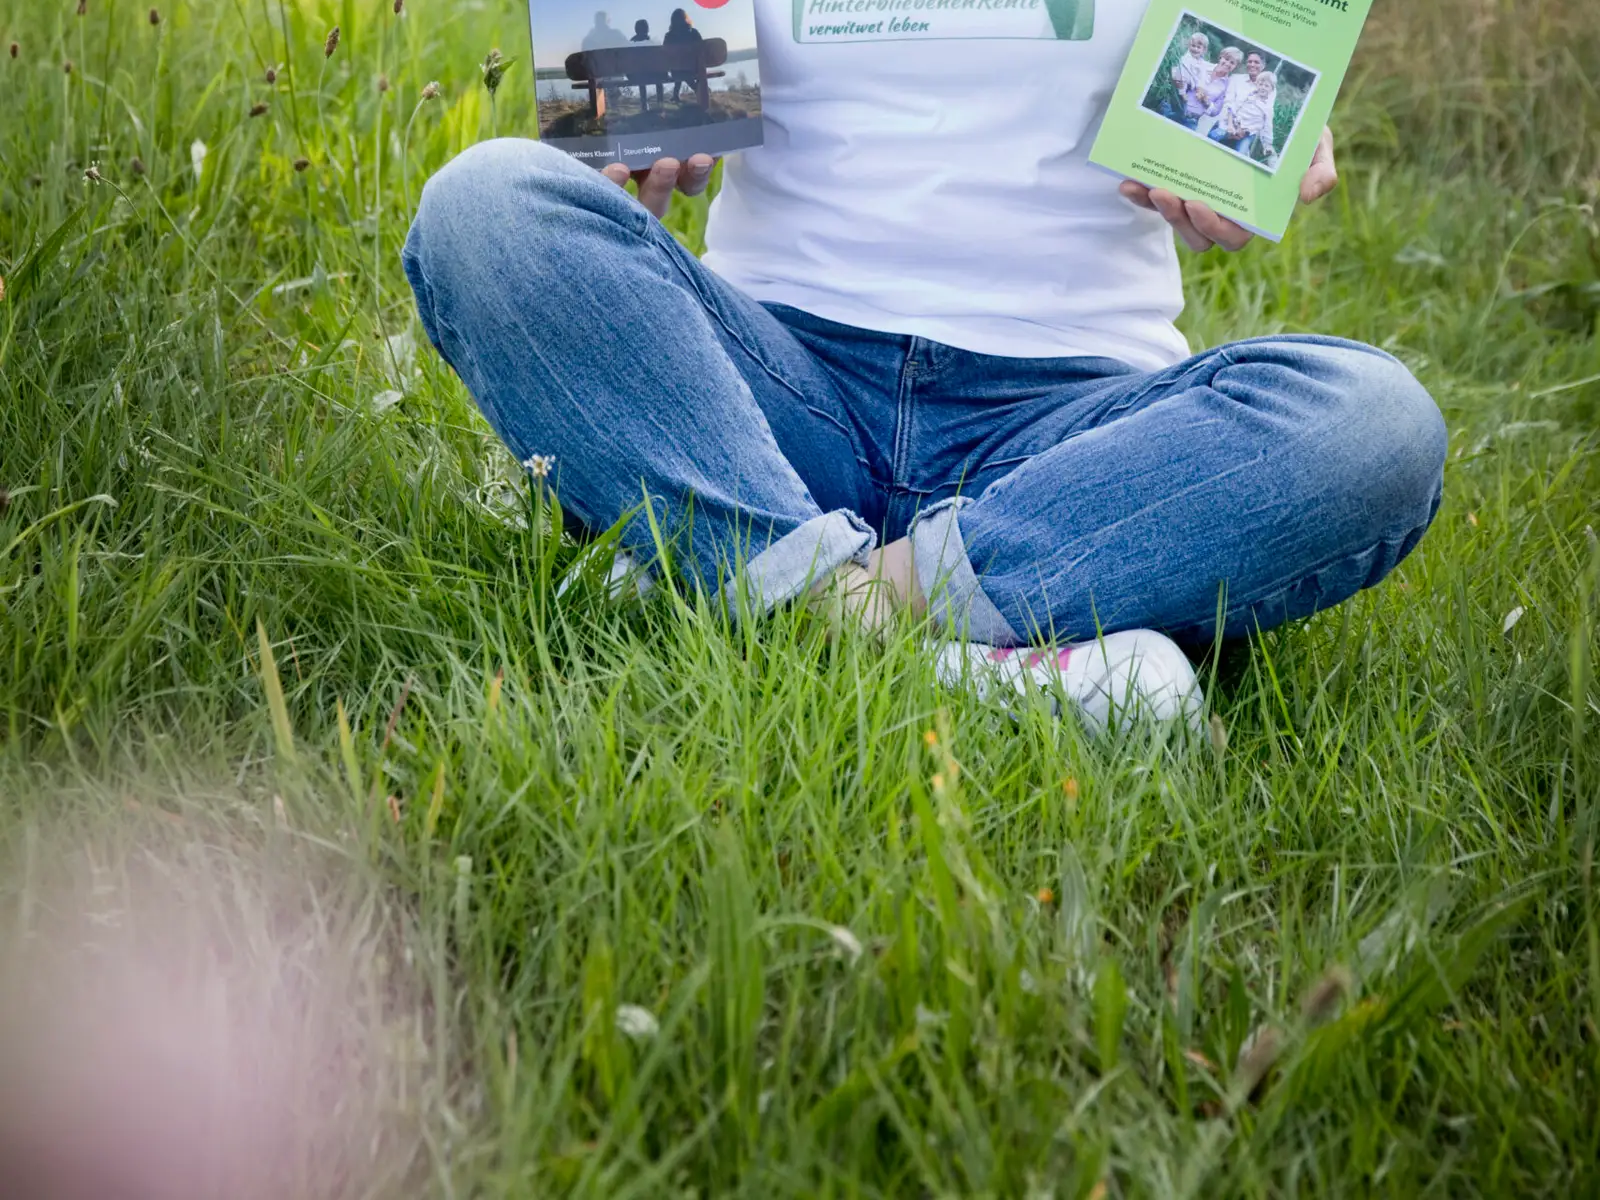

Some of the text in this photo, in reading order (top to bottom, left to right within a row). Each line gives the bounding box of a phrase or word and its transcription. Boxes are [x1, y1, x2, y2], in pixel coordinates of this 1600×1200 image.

[1240, 3, 1260, 14] zwei
[1260, 9, 1292, 27] Kindern
[1292, 11, 1318, 27] Witwe
[809, 16, 930, 36] verwitwet leben
[594, 150, 615, 158] Kluwer
[624, 146, 662, 156] Steuertipps
[1143, 156, 1244, 201] verwitwet-alleinerziehend.de
